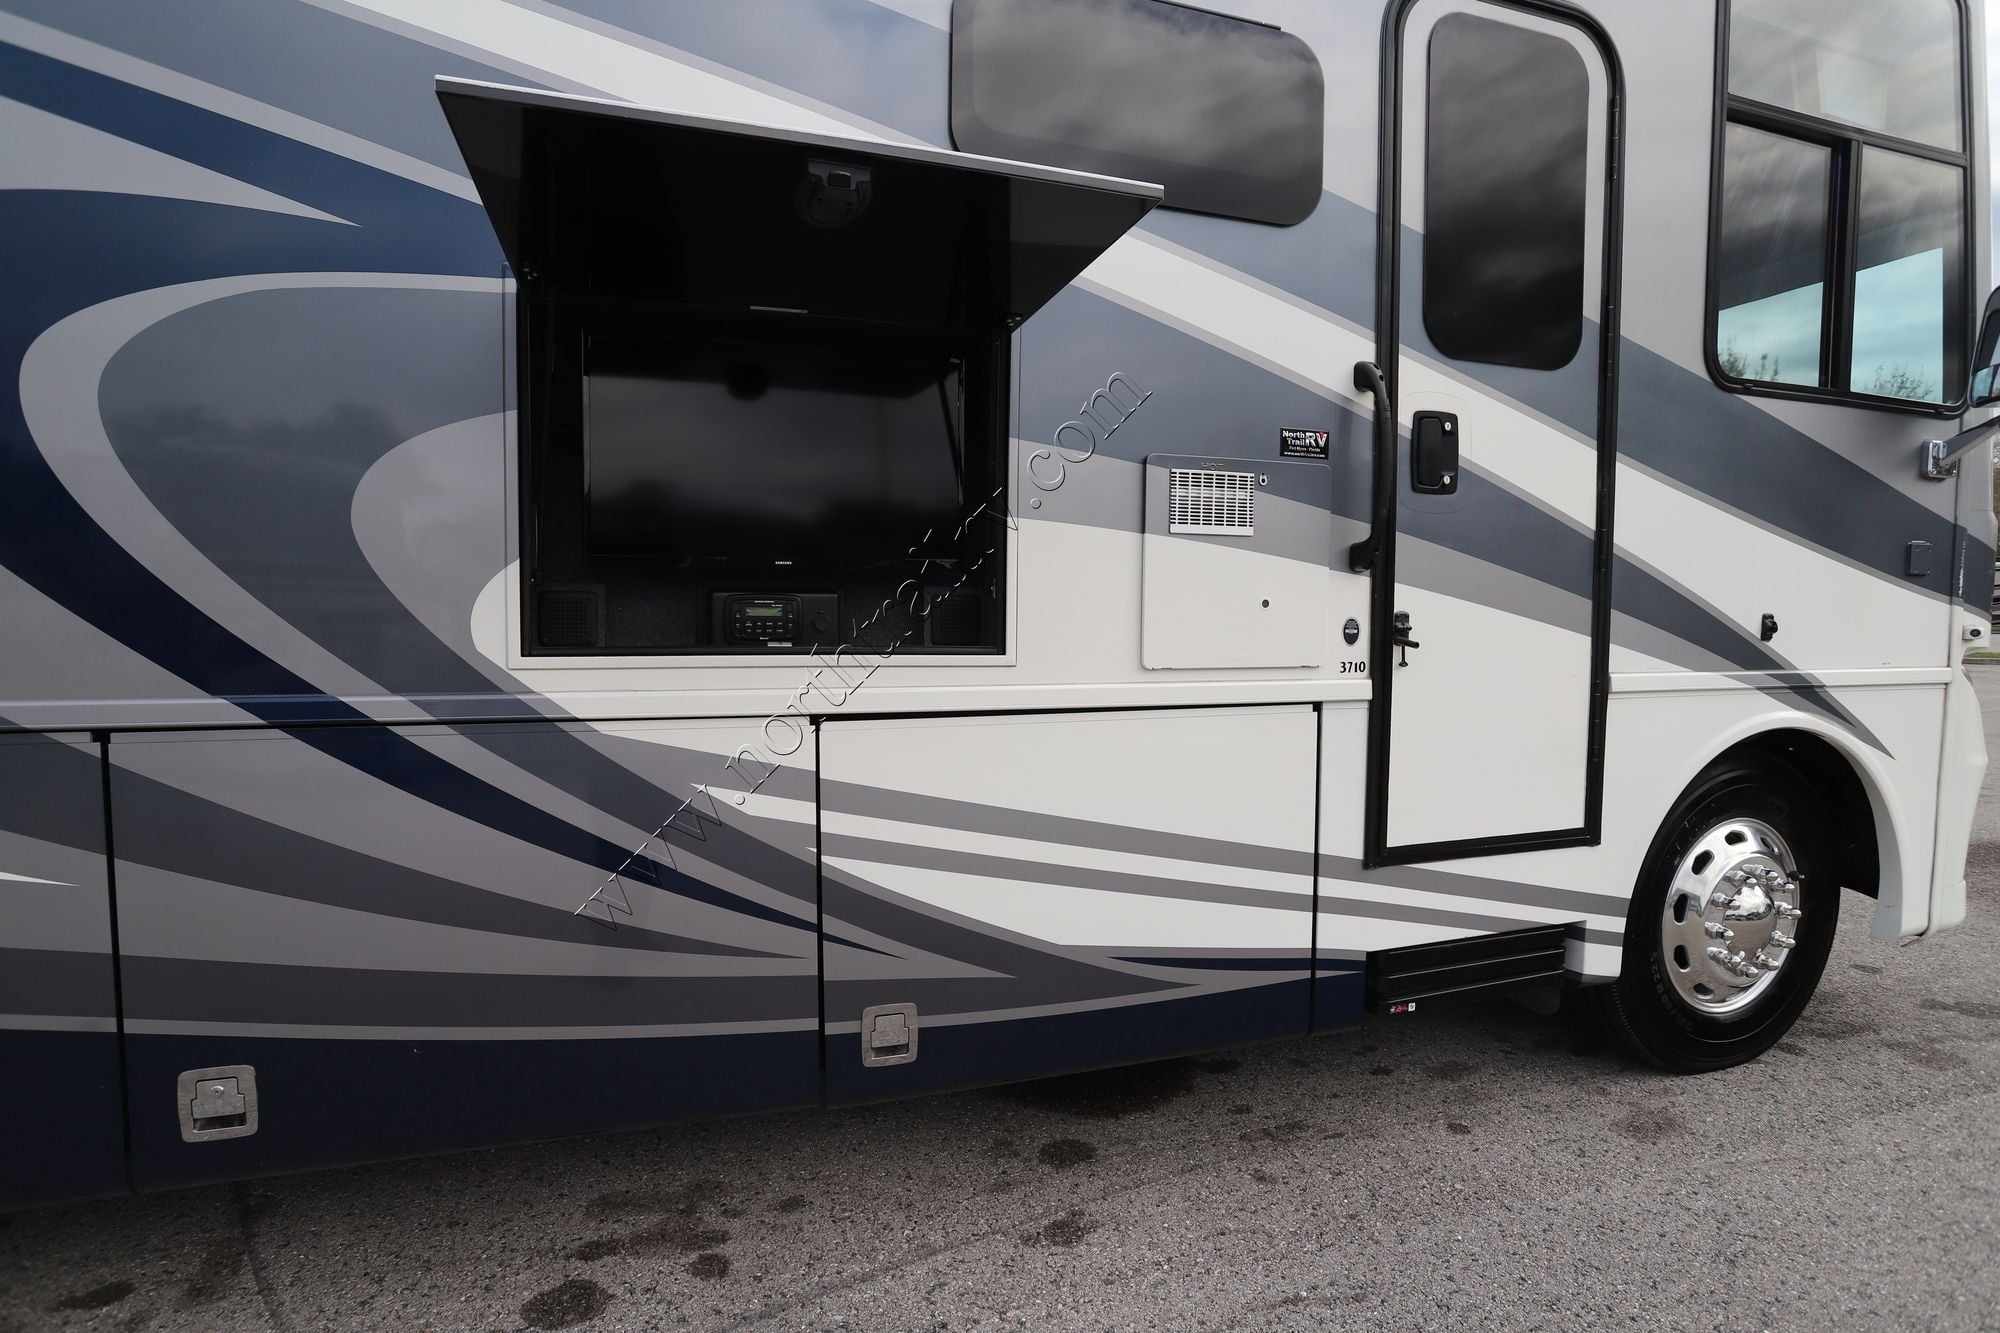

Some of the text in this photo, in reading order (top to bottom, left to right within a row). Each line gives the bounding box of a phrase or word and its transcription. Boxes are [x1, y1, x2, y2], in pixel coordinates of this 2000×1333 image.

[1282, 430, 1305, 439] North
[1305, 432, 1328, 447] RV
[1286, 437, 1305, 446] Trail
[1339, 661, 1366, 673] 3710
